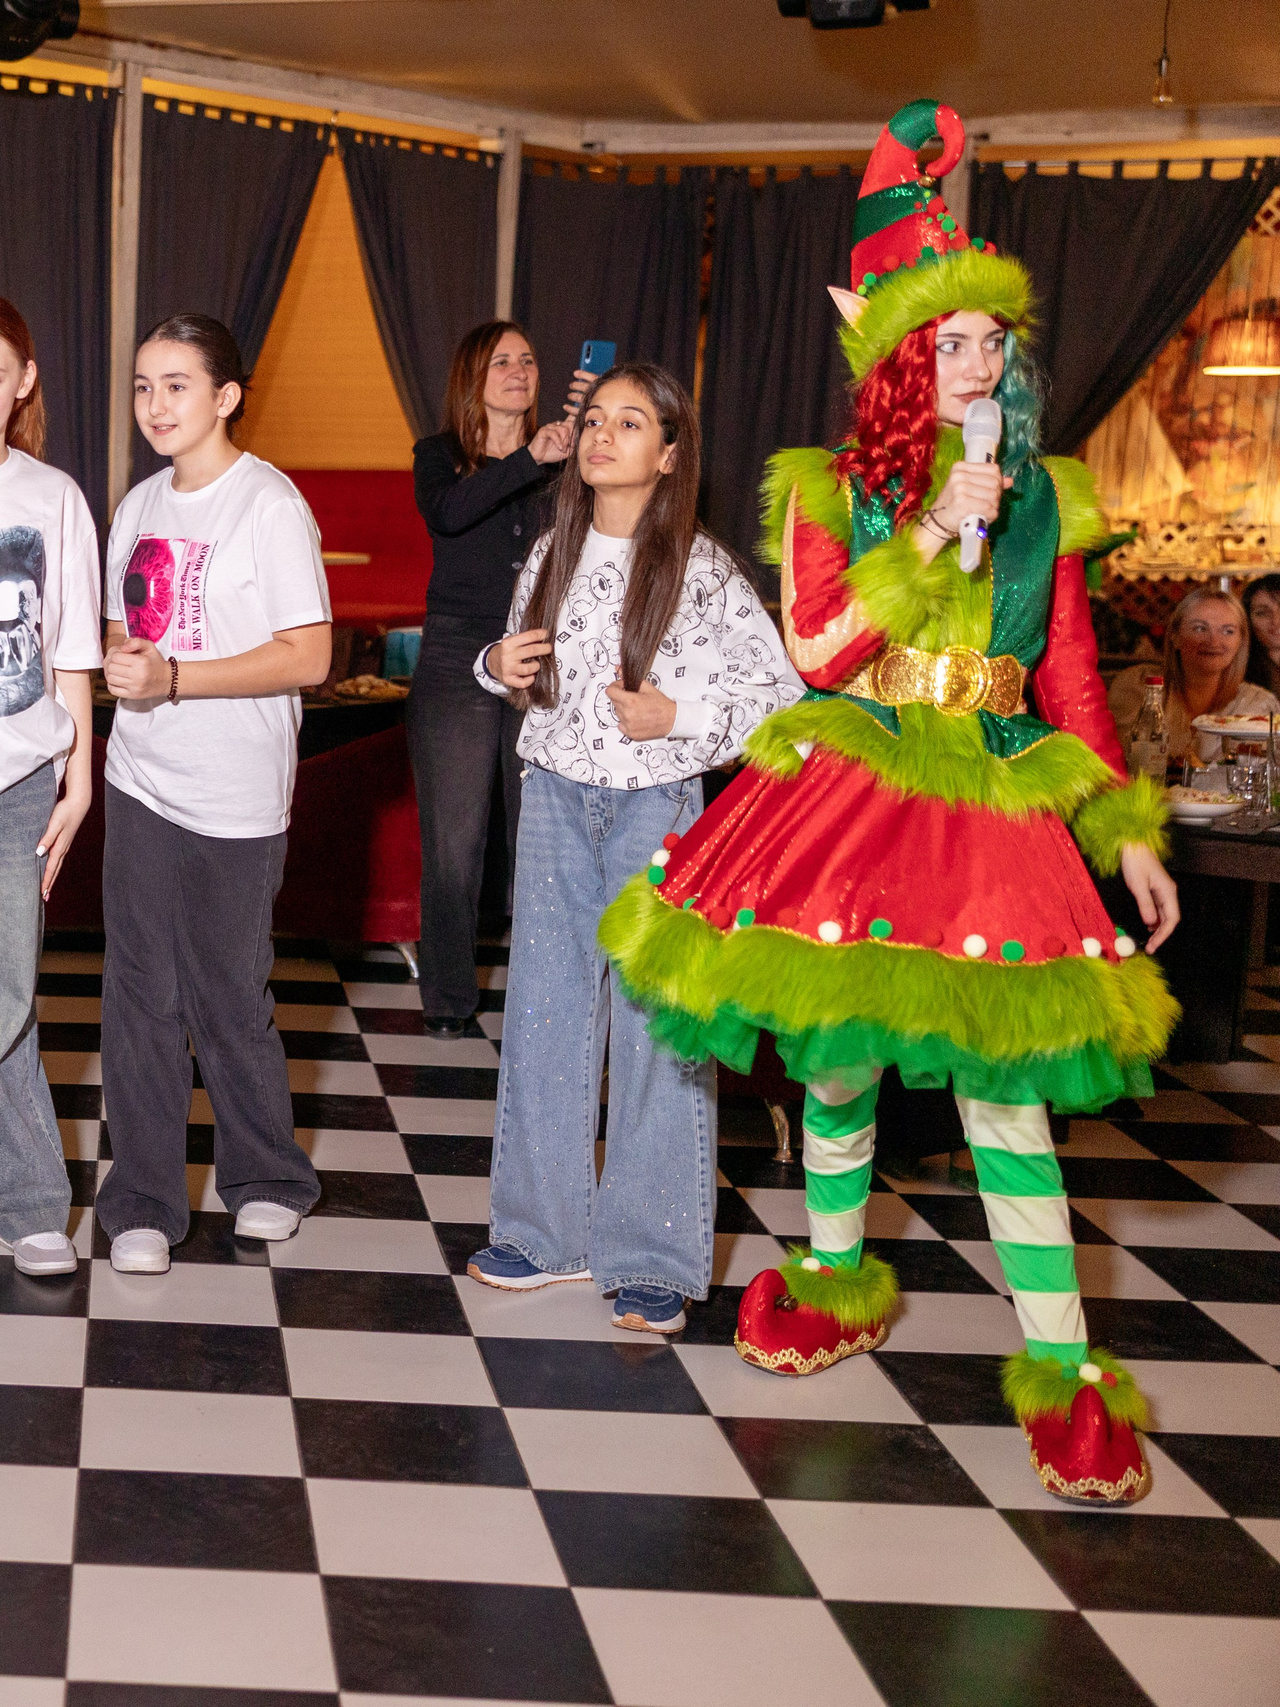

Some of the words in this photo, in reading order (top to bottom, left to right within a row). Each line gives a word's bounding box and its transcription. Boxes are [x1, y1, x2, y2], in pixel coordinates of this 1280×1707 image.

[194, 544, 210, 572] MOON
[180, 562, 191, 582] Times
[191, 575, 200, 591] ON
[178, 601, 186, 616] New
[191, 595, 201, 624] WALK
[178, 617, 186, 630] The
[192, 628, 202, 651] MEN
